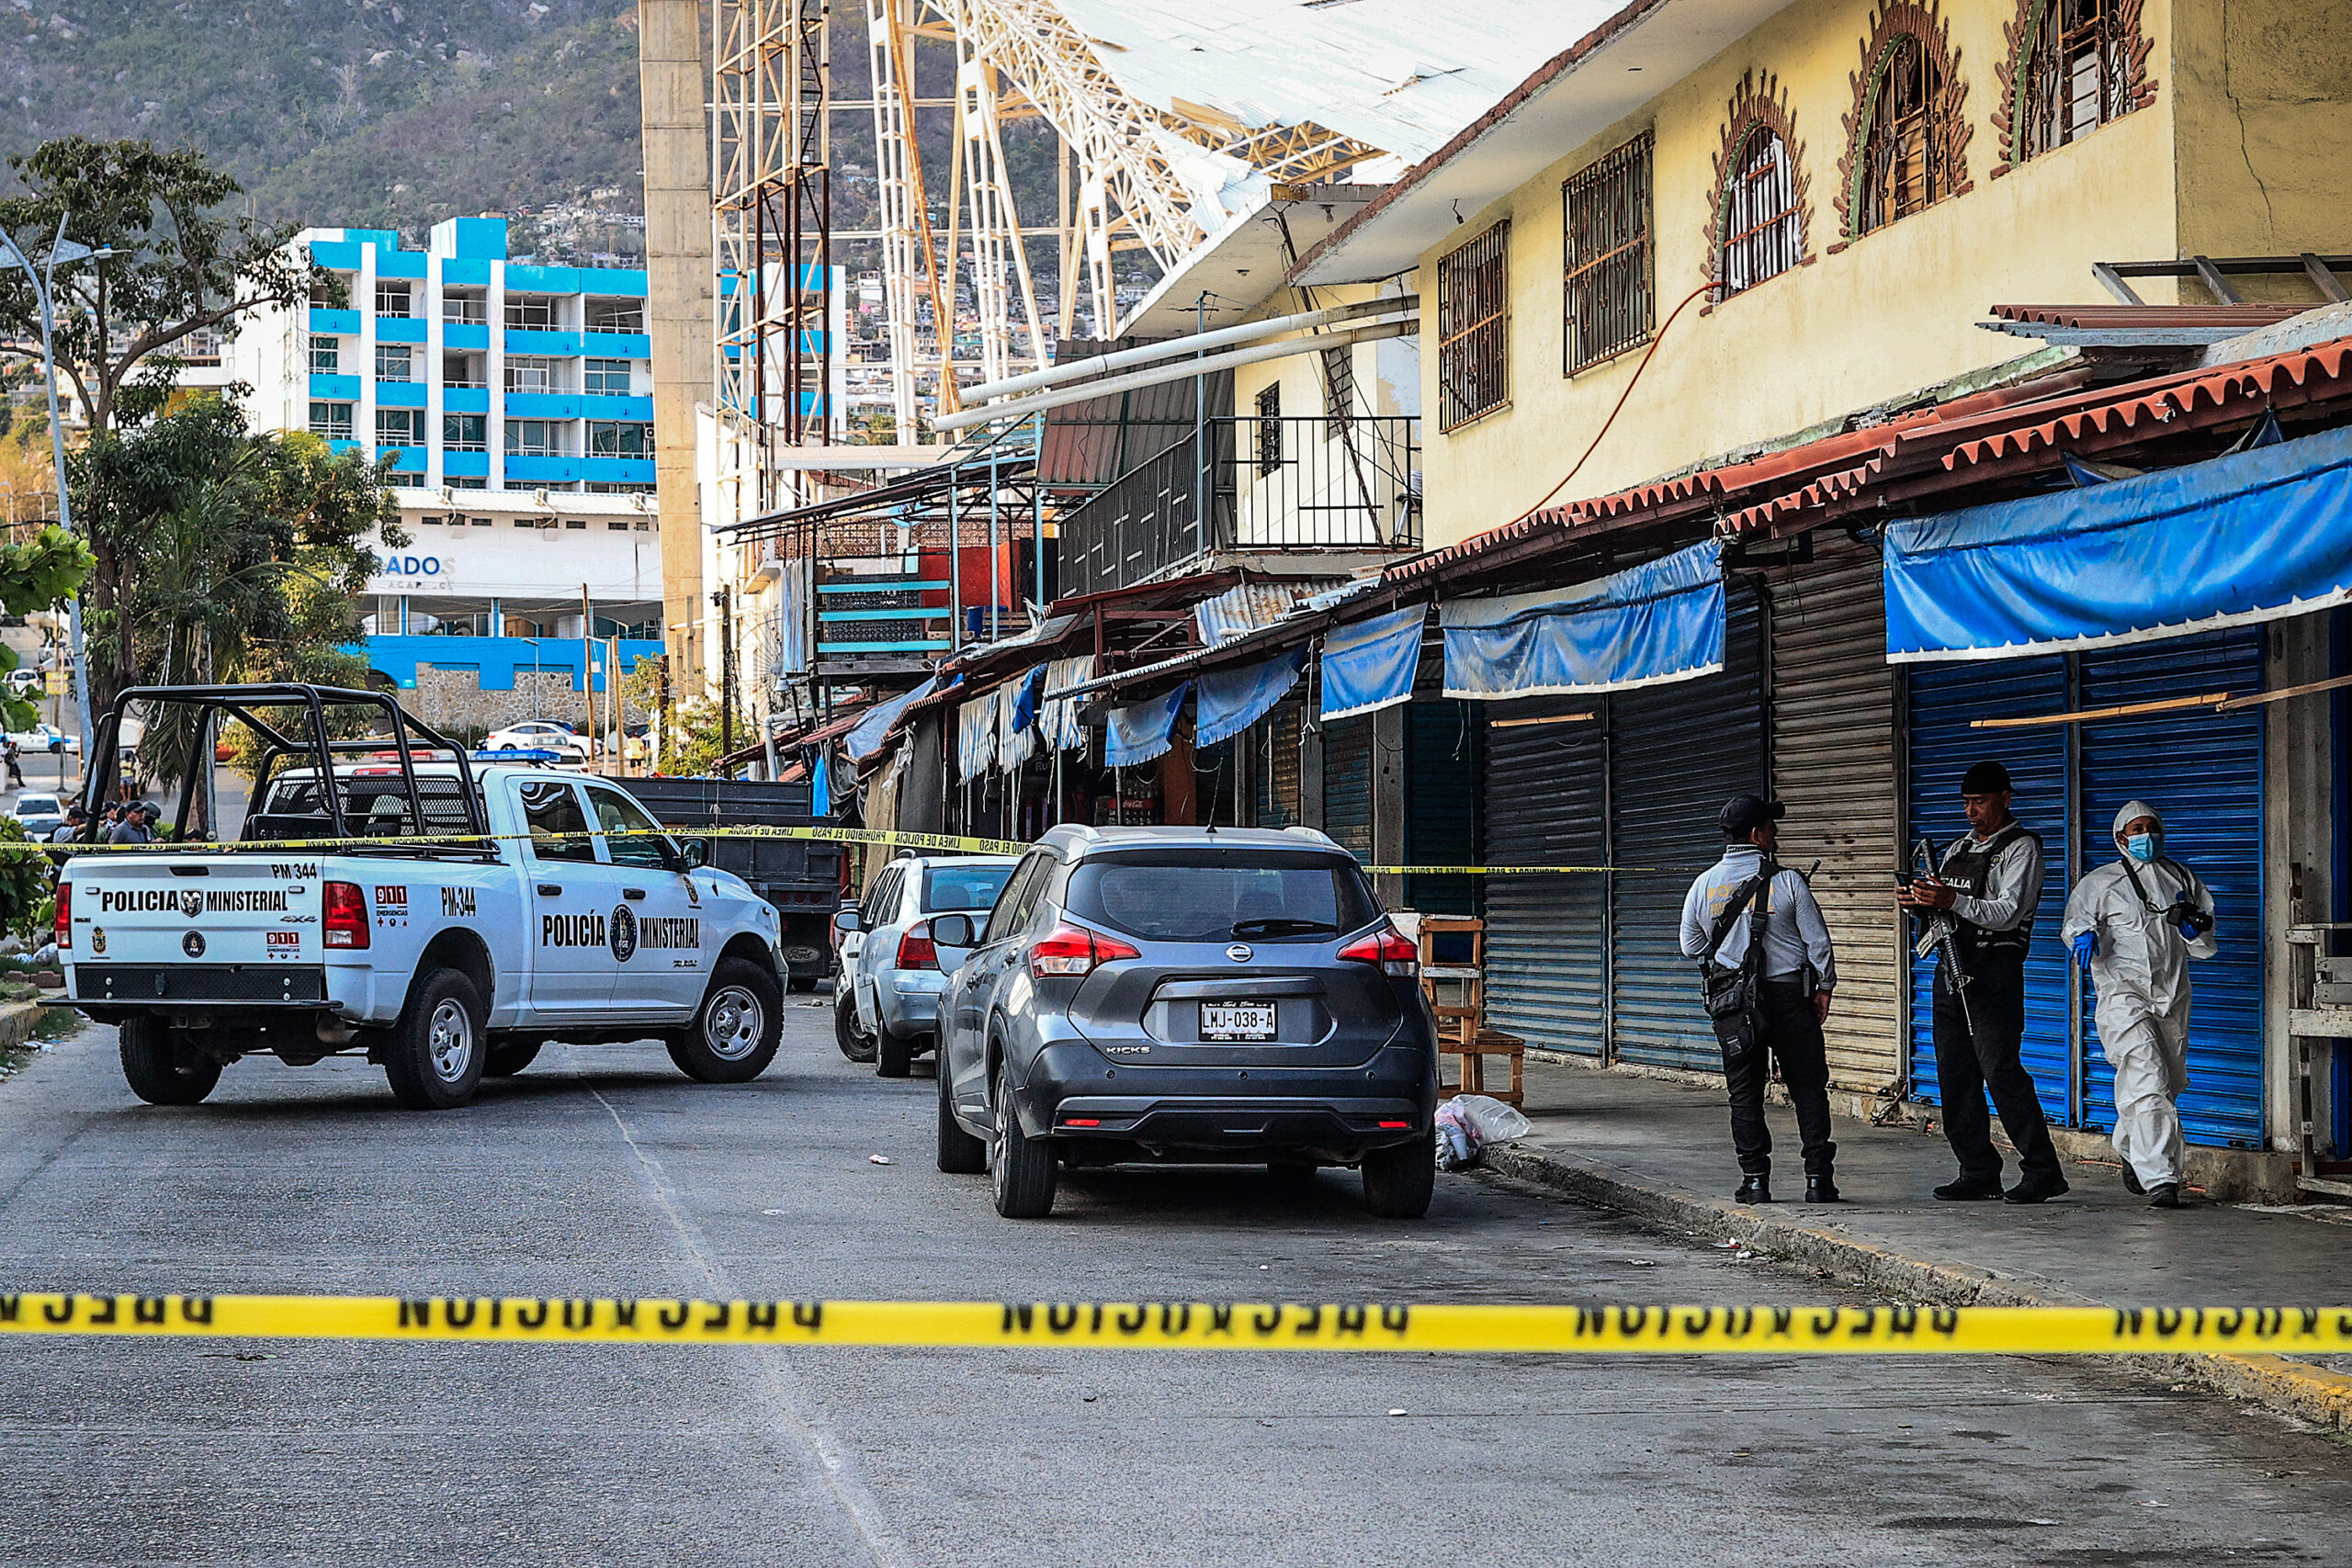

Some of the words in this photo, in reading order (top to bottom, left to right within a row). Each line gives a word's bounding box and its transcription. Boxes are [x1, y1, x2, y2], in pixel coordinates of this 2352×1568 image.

[271, 863, 291, 879] PM
[293, 863, 318, 879] 344
[102, 890, 179, 911] POLICIA
[207, 890, 288, 911] MINISTERIAL
[441, 887, 476, 917] PM-344
[542, 909, 606, 947] POLICÍA
[639, 918, 700, 949] MINISTERIAL
[1203, 1011, 1273, 1028] LMJ-038-A
[1106, 1046, 1151, 1055] KICKS
